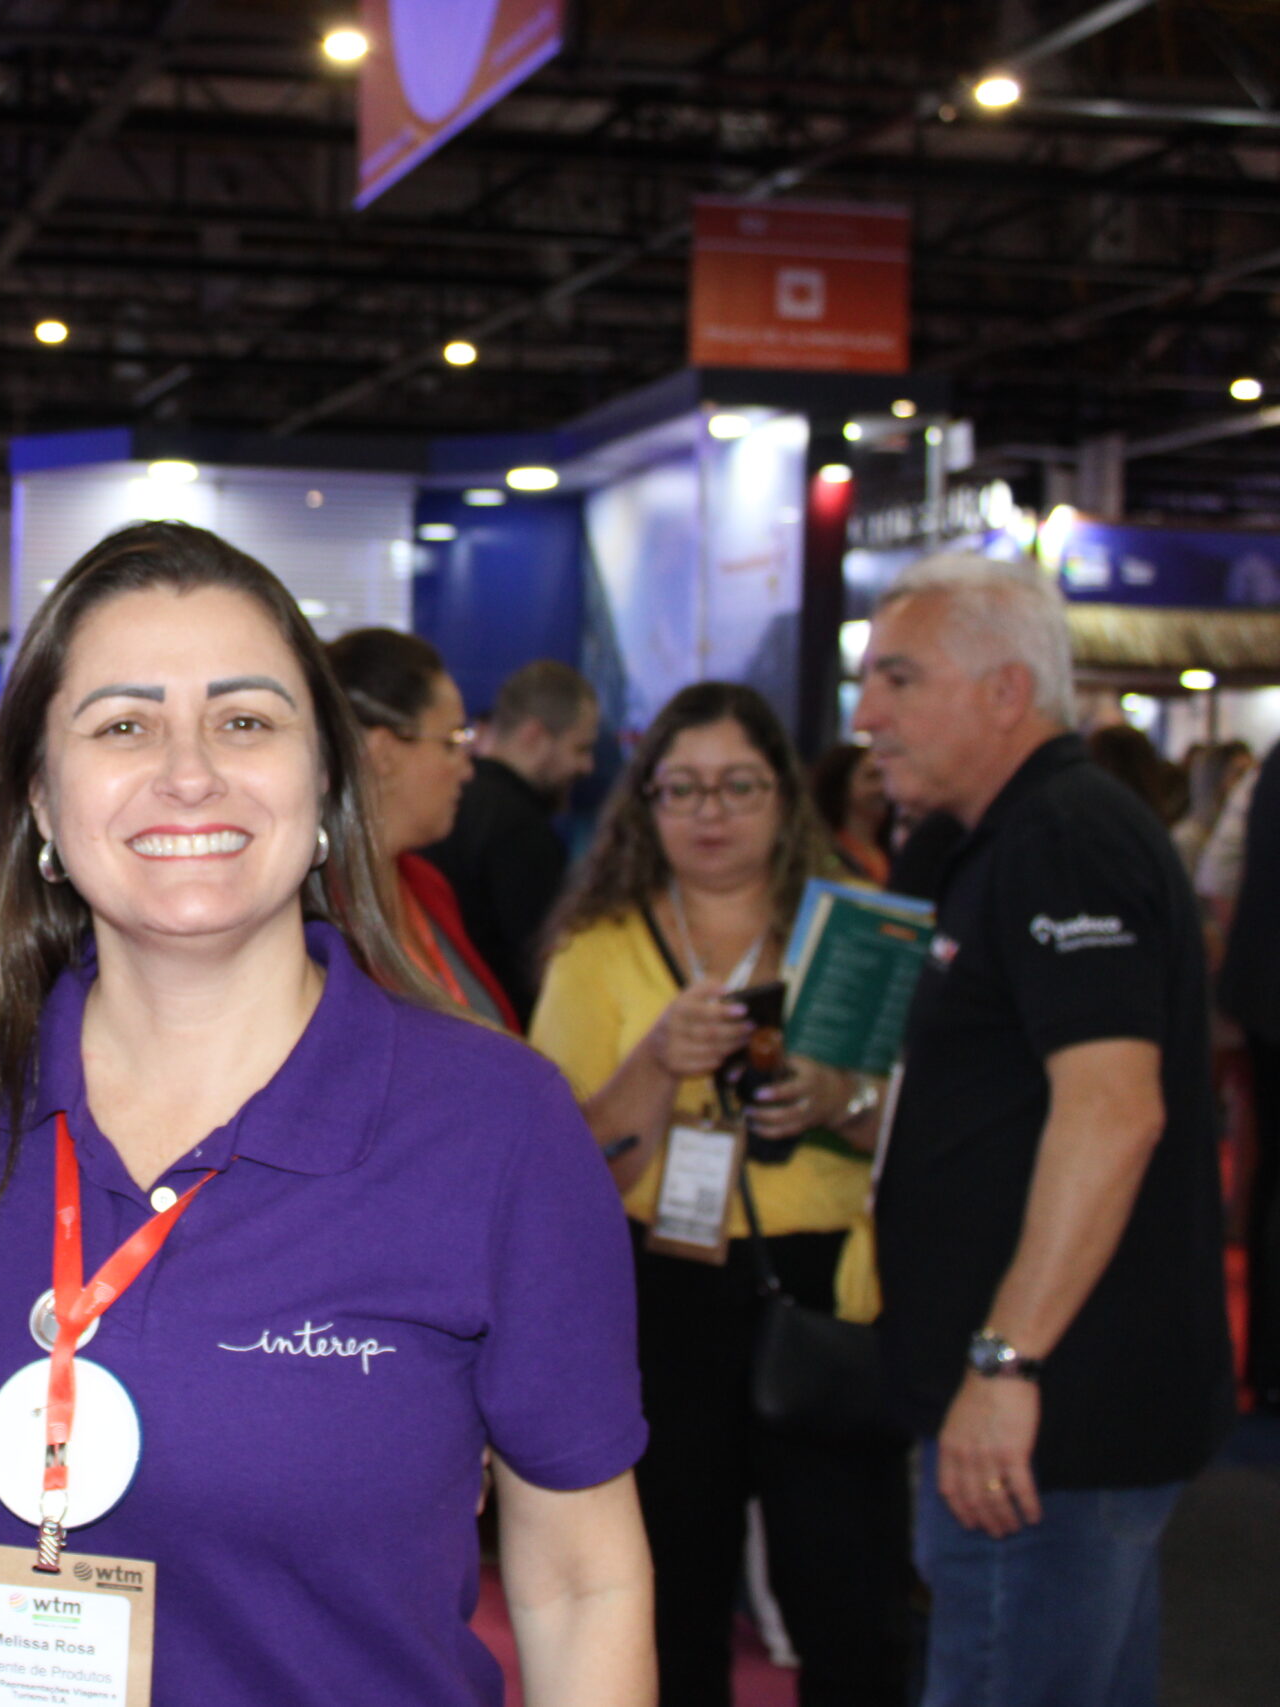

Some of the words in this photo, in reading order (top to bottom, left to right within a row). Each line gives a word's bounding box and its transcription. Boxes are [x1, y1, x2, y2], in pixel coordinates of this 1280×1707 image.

[218, 1321, 397, 1375] interep
[95, 1565, 143, 1585] wtm
[33, 1597, 81, 1615] wtm
[55, 1639, 96, 1655] Rosa
[31, 1664, 48, 1677] de
[51, 1666, 113, 1684] Produtos
